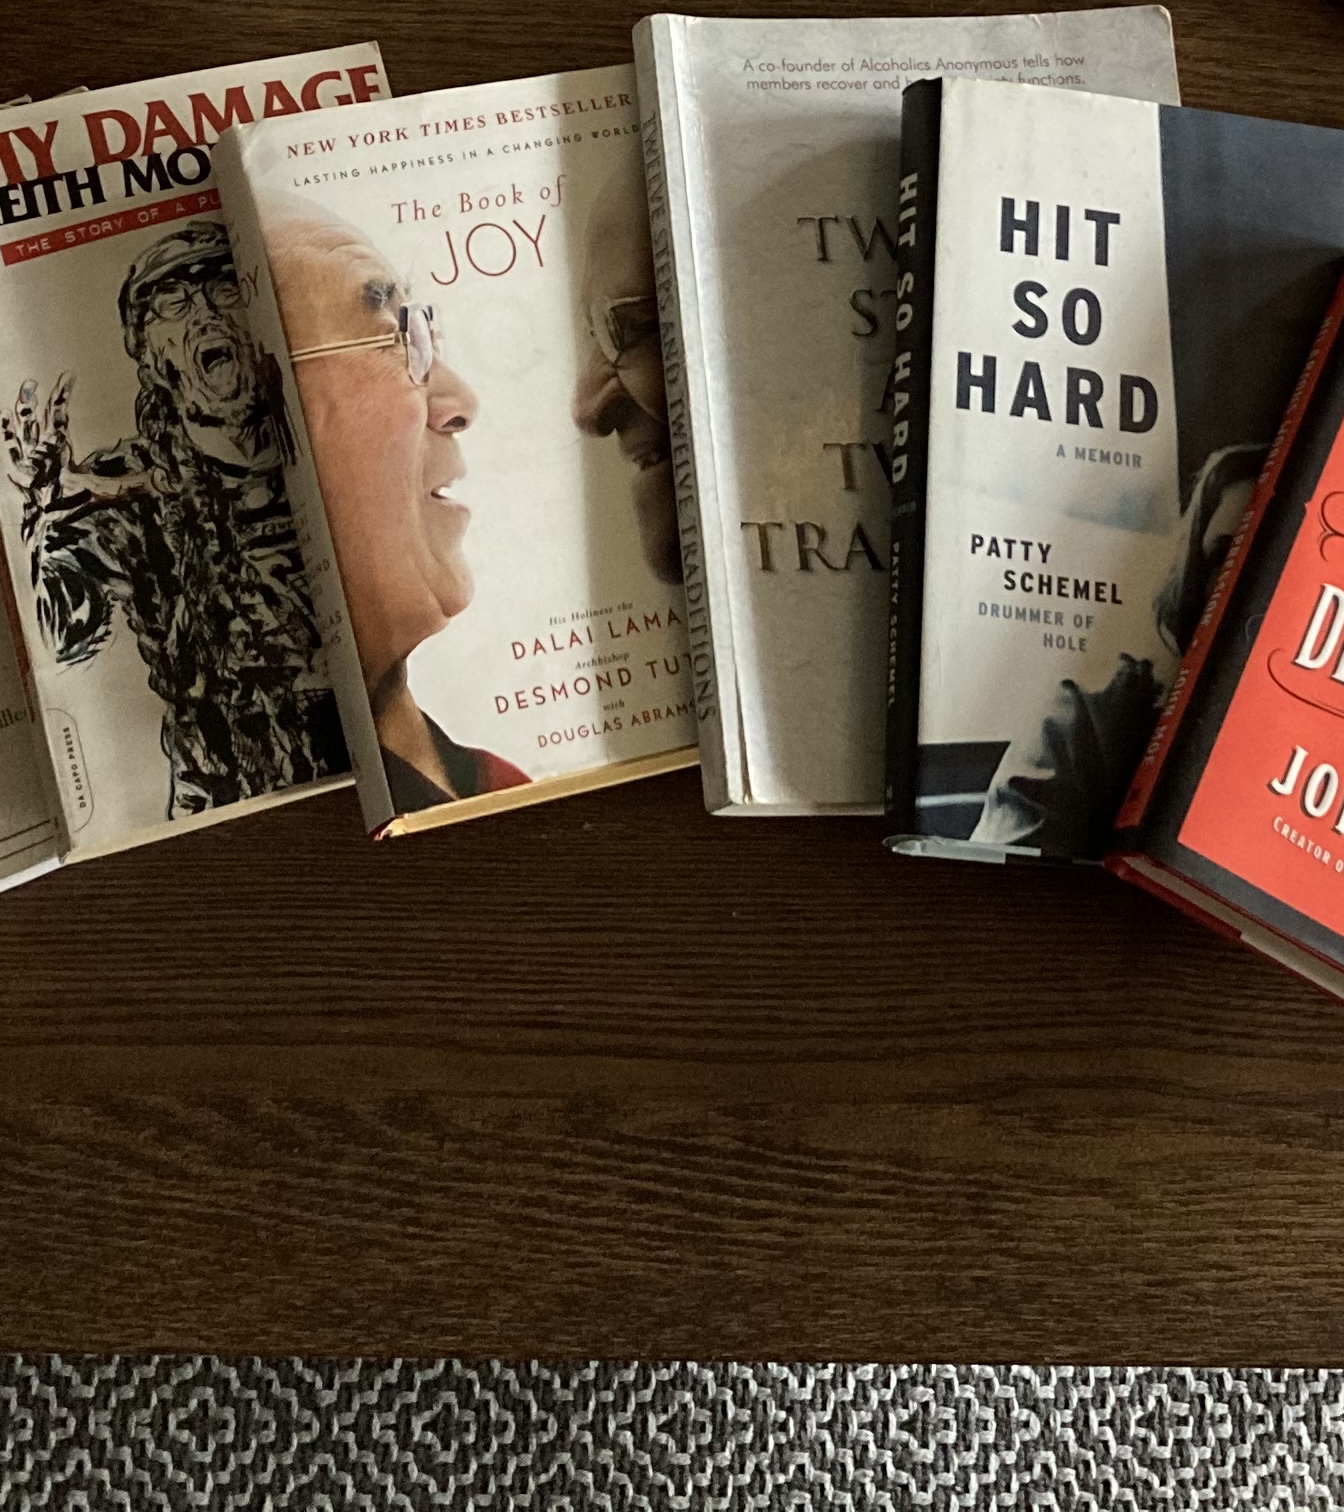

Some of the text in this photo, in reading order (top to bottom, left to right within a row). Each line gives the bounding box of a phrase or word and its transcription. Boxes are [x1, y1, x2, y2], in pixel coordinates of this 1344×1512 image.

[743, 54, 1085, 74] A co-founder of Alcoholics Anonymous tells how
[746, 76, 811, 91] members
[816, 80, 868, 91] recover
[873, 75, 900, 90] and
[82, 63, 381, 165] DAMAGE
[286, 93, 633, 160] NEW YORK TIMES BESTSELLER
[120, 143, 217, 199] MO
[293, 124, 641, 188] LASTING HAPPINESS IN A CHANGING WORLD
[391, 174, 567, 225] The Book of
[899, 172, 918, 248] HIT
[15, 238, 51, 257] THE
[64, 217, 125, 243] STORY
[137, 208, 159, 223] OF
[175, 202, 186, 214] A
[430, 214, 547, 286] JOY
[796, 214, 899, 263] TW
[1000, 196, 1121, 267] HIT
[896, 272, 914, 331] SO
[1011, 280, 1102, 346] SO
[892, 351, 911, 484] HARD
[956, 351, 1158, 433] HARD
[1056, 443, 1142, 469] A MEMOIR
[740, 517, 891, 573] TRA
[971, 533, 1052, 564] PATTY
[549, 600, 634, 627] His Holiness the
[1003, 569, 1123, 605] SCHEMEL
[511, 608, 683, 660] DALAI LAMA
[681, 523, 717, 722] TRADITIONS
[978, 601, 1095, 629] DRUMMER OF
[575, 651, 630, 671] Archbishop
[1043, 633, 1088, 653] HOLE
[494, 652, 692, 714] DESMOND TUT
[602, 700, 625, 712] with
[537, 716, 623, 748] DOUGLAS
[62, 726, 87, 809] DA CAPO PRESS
[1272, 815, 1332, 865] CREATOR
